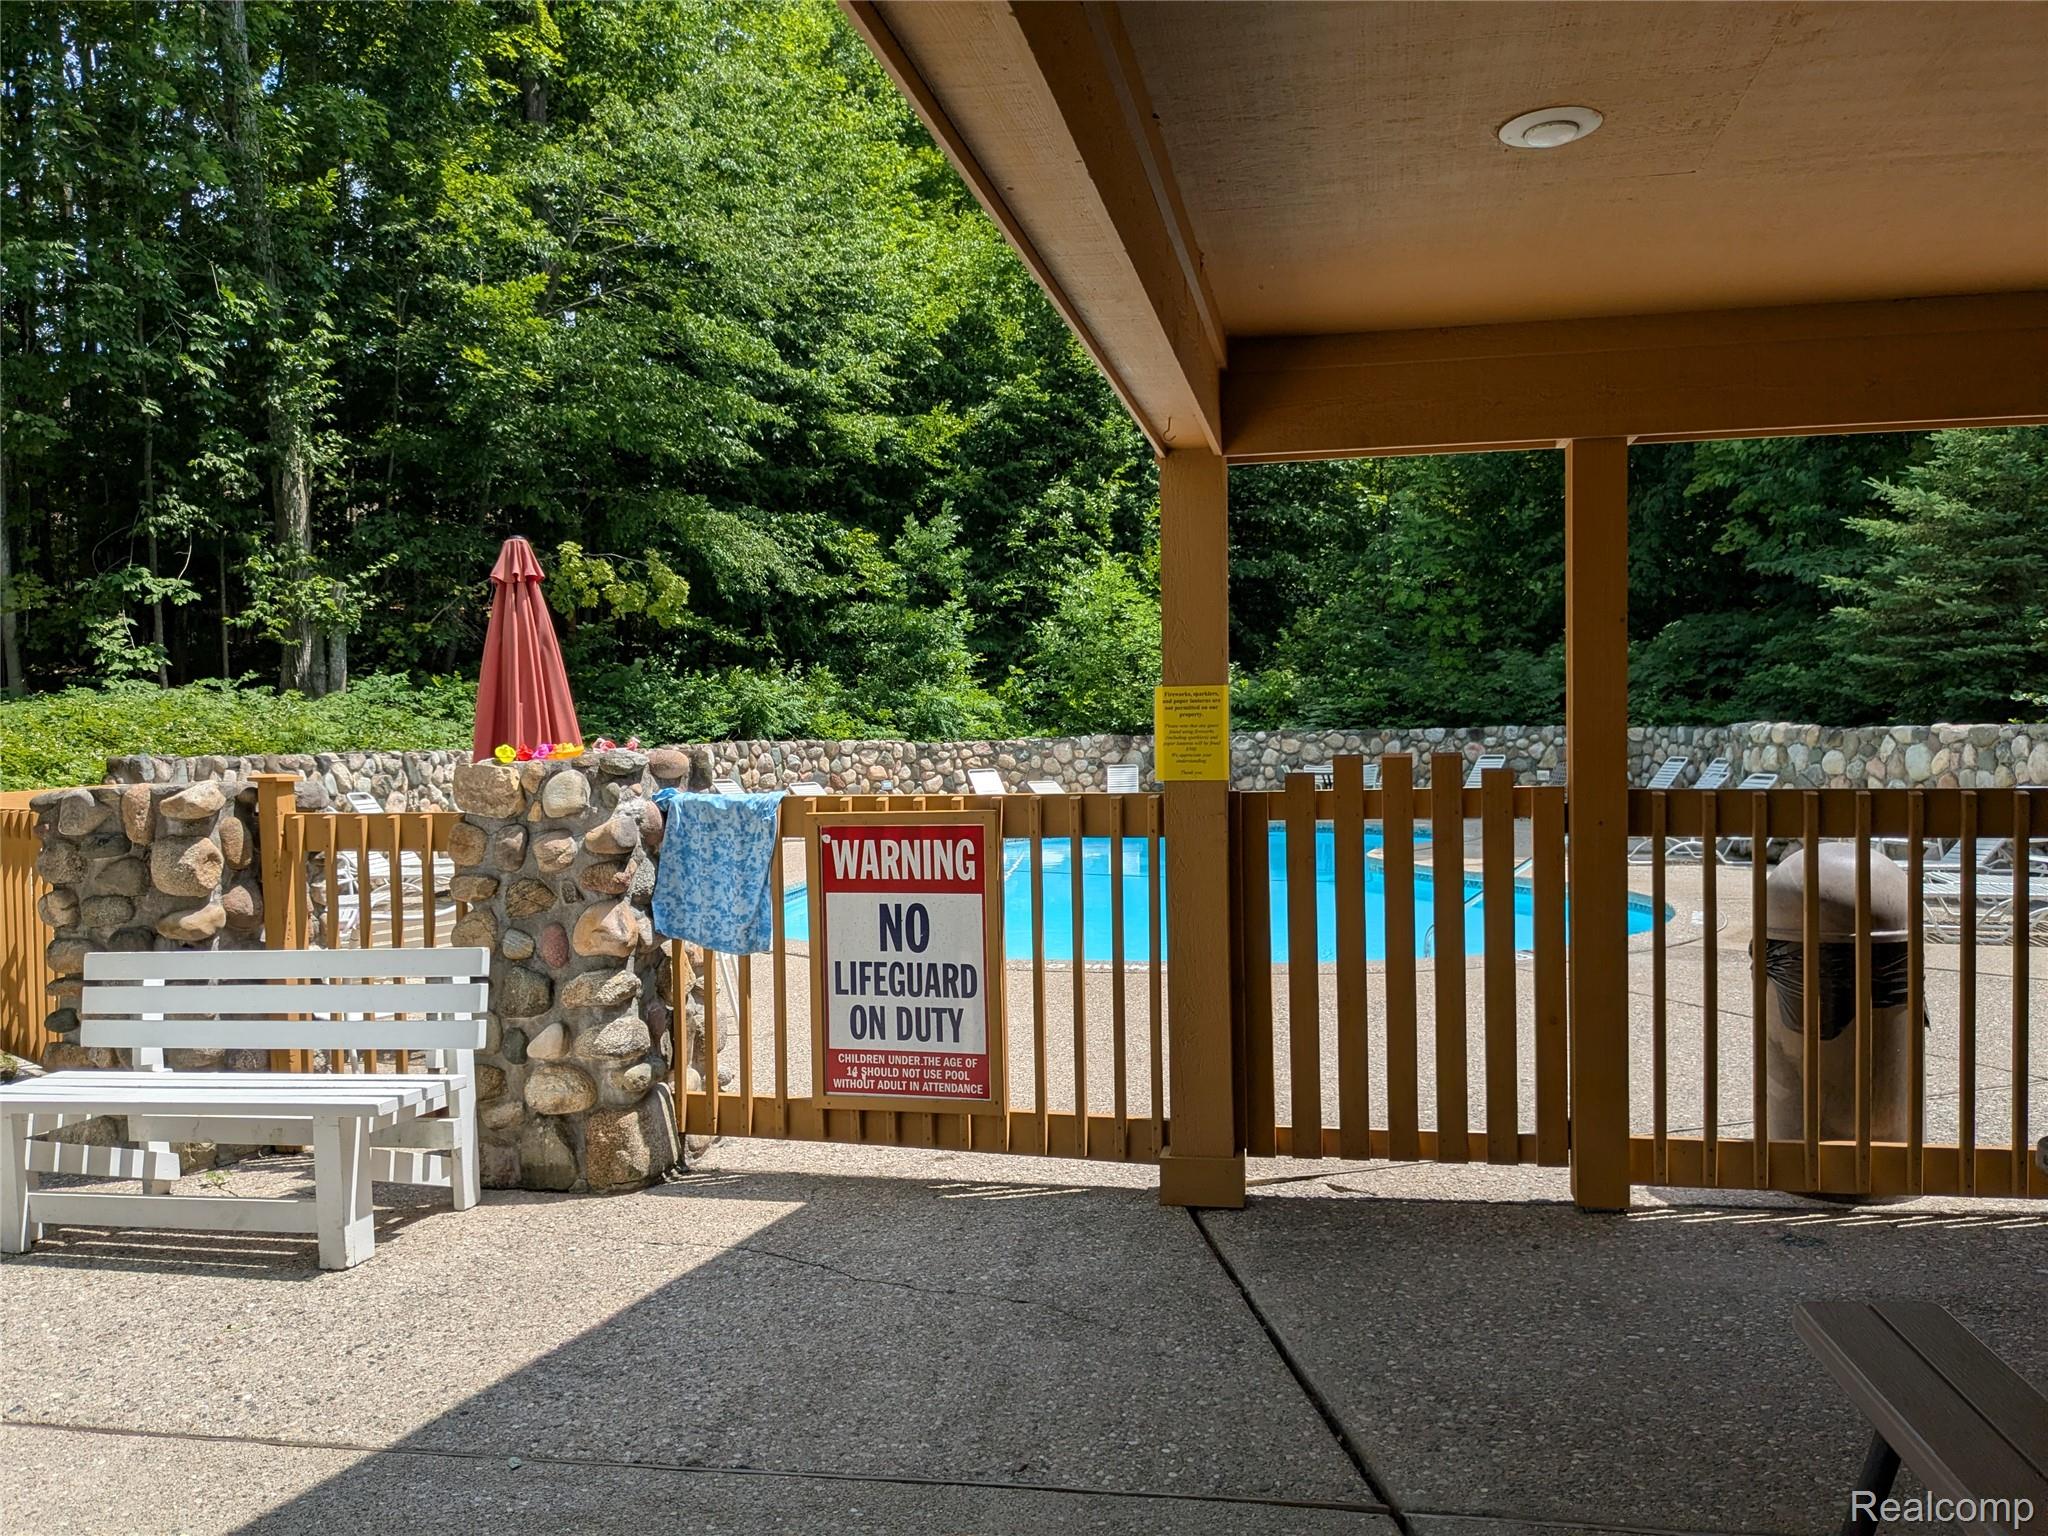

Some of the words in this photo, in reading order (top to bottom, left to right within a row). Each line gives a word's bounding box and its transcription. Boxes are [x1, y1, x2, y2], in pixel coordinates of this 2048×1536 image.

[830, 838, 976, 880] WARNING
[879, 902, 930, 953] NO
[834, 960, 978, 999] LIFEGUARD
[850, 1004, 886, 1040] ON
[896, 1006, 964, 1042] DUTY
[838, 1054, 885, 1064] CHILDREN
[924, 1056, 941, 1066] THE
[943, 1058, 962, 1067] AGE
[965, 1058, 978, 1068] OF
[861, 1066, 899, 1078] SHOULD
[902, 1068, 921, 1078] NOT
[923, 1070, 942, 1079] USE
[945, 1070, 970, 1080] POOL
[833, 1078, 875, 1089] WITHOUT
[877, 1080, 907, 1091] ADULT
[910, 1082, 920, 1091] IN
[922, 1082, 983, 1094] ATTENDANCE
